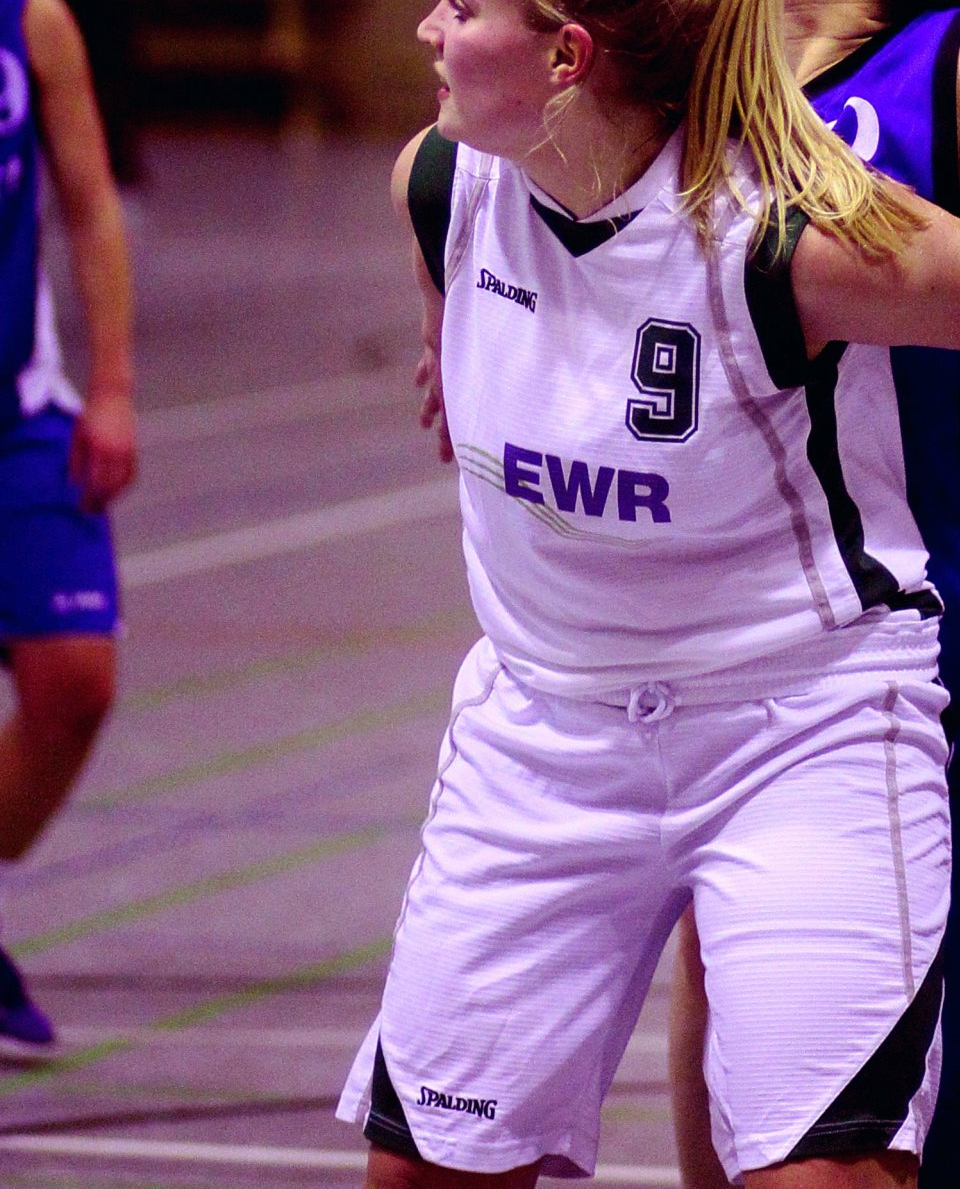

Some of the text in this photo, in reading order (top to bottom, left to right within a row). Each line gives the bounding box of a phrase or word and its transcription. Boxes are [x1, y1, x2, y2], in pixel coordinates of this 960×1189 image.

[476, 268, 538, 314] SPALDING
[625, 317, 701, 444] 9
[503, 442, 671, 523] EWR
[417, 1086, 498, 1120] SPALDING
